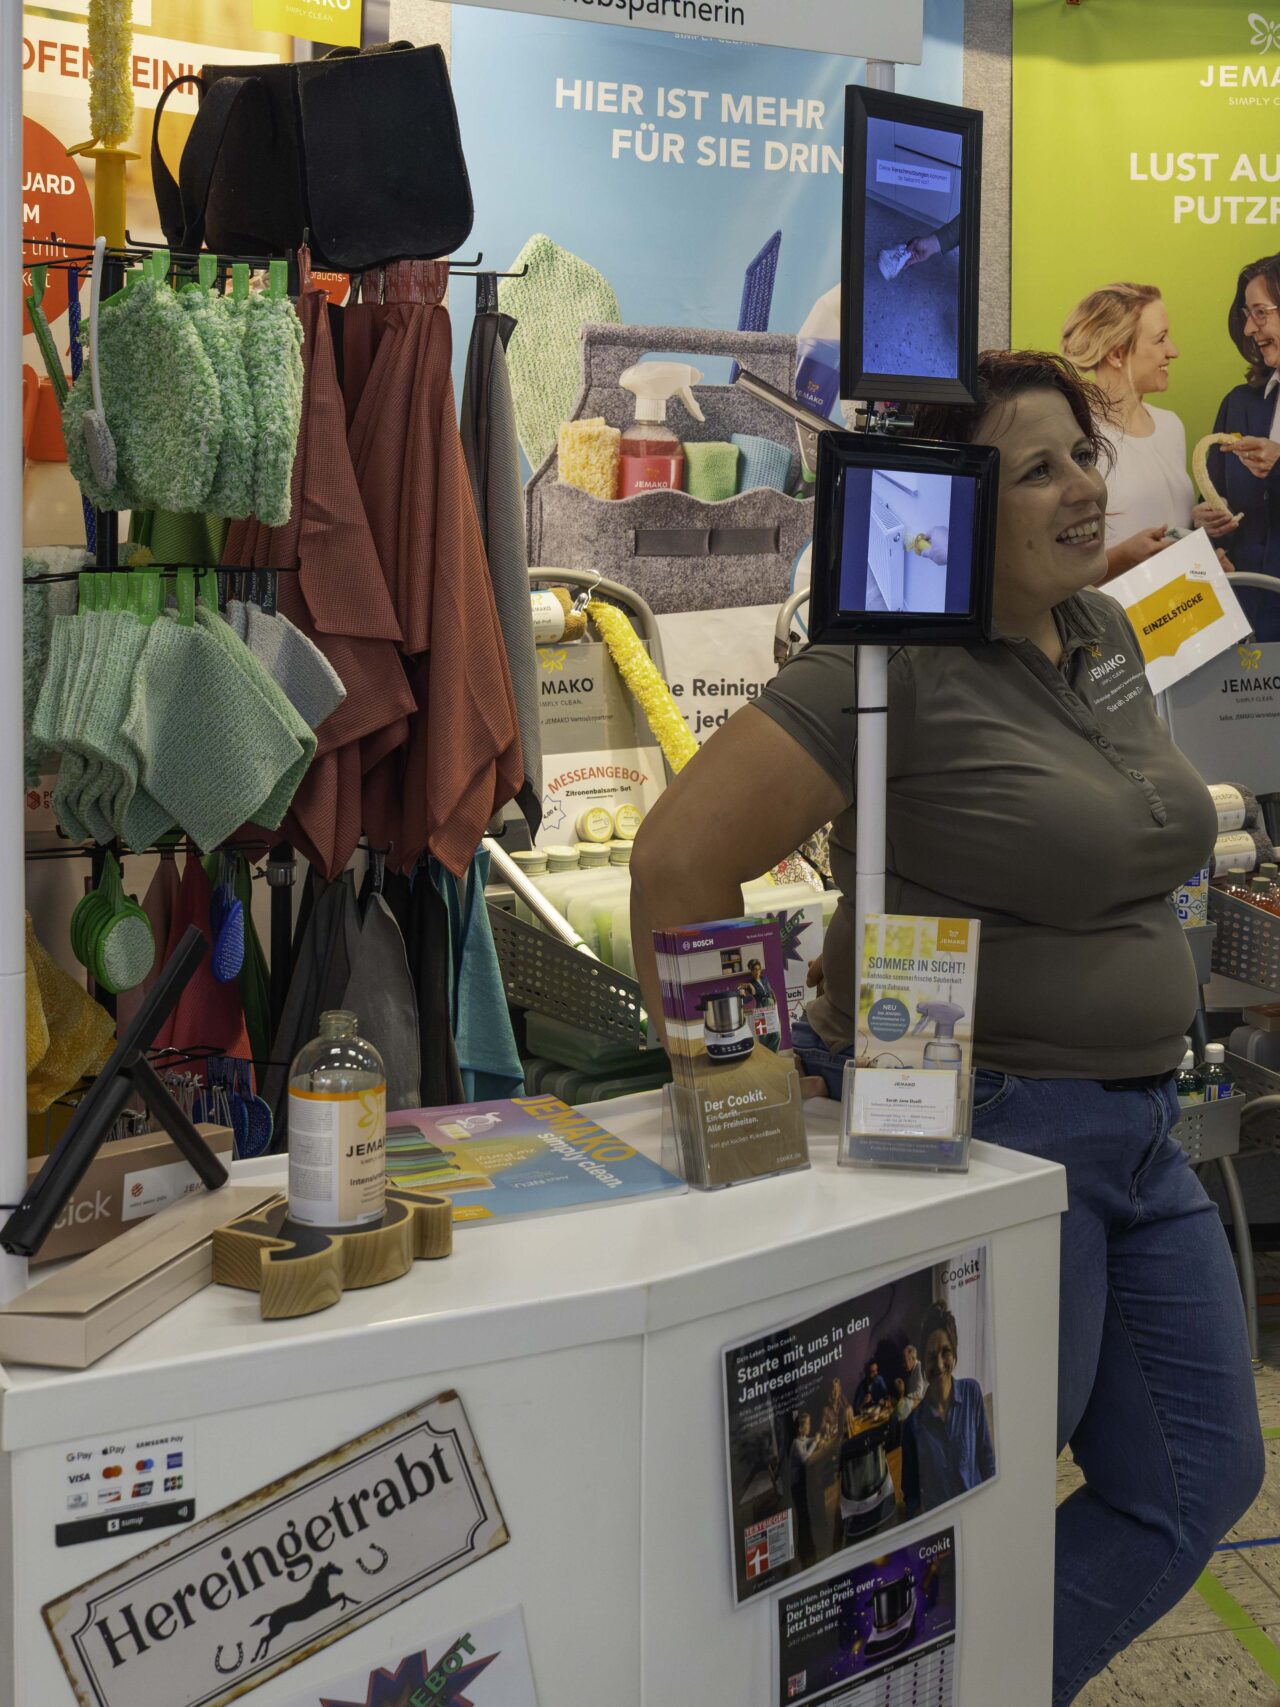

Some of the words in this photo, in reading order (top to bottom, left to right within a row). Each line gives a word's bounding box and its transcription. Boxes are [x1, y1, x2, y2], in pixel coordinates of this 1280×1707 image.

[555, 78, 645, 116] HIER
[656, 87, 710, 120] IST
[721, 94, 826, 130] MEHR
[1228, 96, 1271, 106] SIMPLY
[611, 122, 685, 164] FÜR
[696, 136, 752, 169] SIE
[1129, 152, 1219, 183] LUST
[634, 480, 668, 488] JEMAKO
[1142, 592, 1204, 636] EINZELSTÜCKE
[1088, 653, 1126, 682] JEMAKO
[692, 678, 765, 701] Reinig
[547, 766, 649, 794] MESSEANGEBOT
[692, 938, 714, 948] BOSCH
[868, 956, 915, 971] SOMMER
[917, 959, 928, 972] IN
[930, 960, 966, 974] SICHT!
[704, 1099, 724, 1113] Der
[727, 1088, 768, 1107] Cookit.
[511, 1096, 639, 1162] JEMAKO
[706, 1114, 719, 1123] Ein
[707, 1123, 722, 1134] Alle
[723, 1116, 760, 1130] Freiheiten.
[346, 1139, 385, 1158] JEMA
[537, 1132, 588, 1161] simply
[578, 1161, 623, 1189] clean.
[941, 1259, 980, 1285] Cookit
[737, 1357, 779, 1384] Starte
[783, 1344, 805, 1366] mit
[807, 1334, 829, 1354] uns
[832, 1326, 844, 1343] in
[847, 1316, 870, 1335] den
[738, 1343, 844, 1404] Jahresendspurt!
[76, 1451, 93, 1461] Pay
[108, 1446, 126, 1456] Pay
[68, 1472, 91, 1485] VISA
[95, 1442, 454, 1669] Hereingetrabt
[919, 1536, 951, 1560] Cookit
[786, 1609, 804, 1624] Der
[805, 1598, 830, 1616] beste
[832, 1586, 855, 1604] Preis
[856, 1578, 875, 1593] ever
[786, 1619, 808, 1638] jetzt
[809, 1611, 824, 1627] bei
[825, 1603, 843, 1619] mir.
